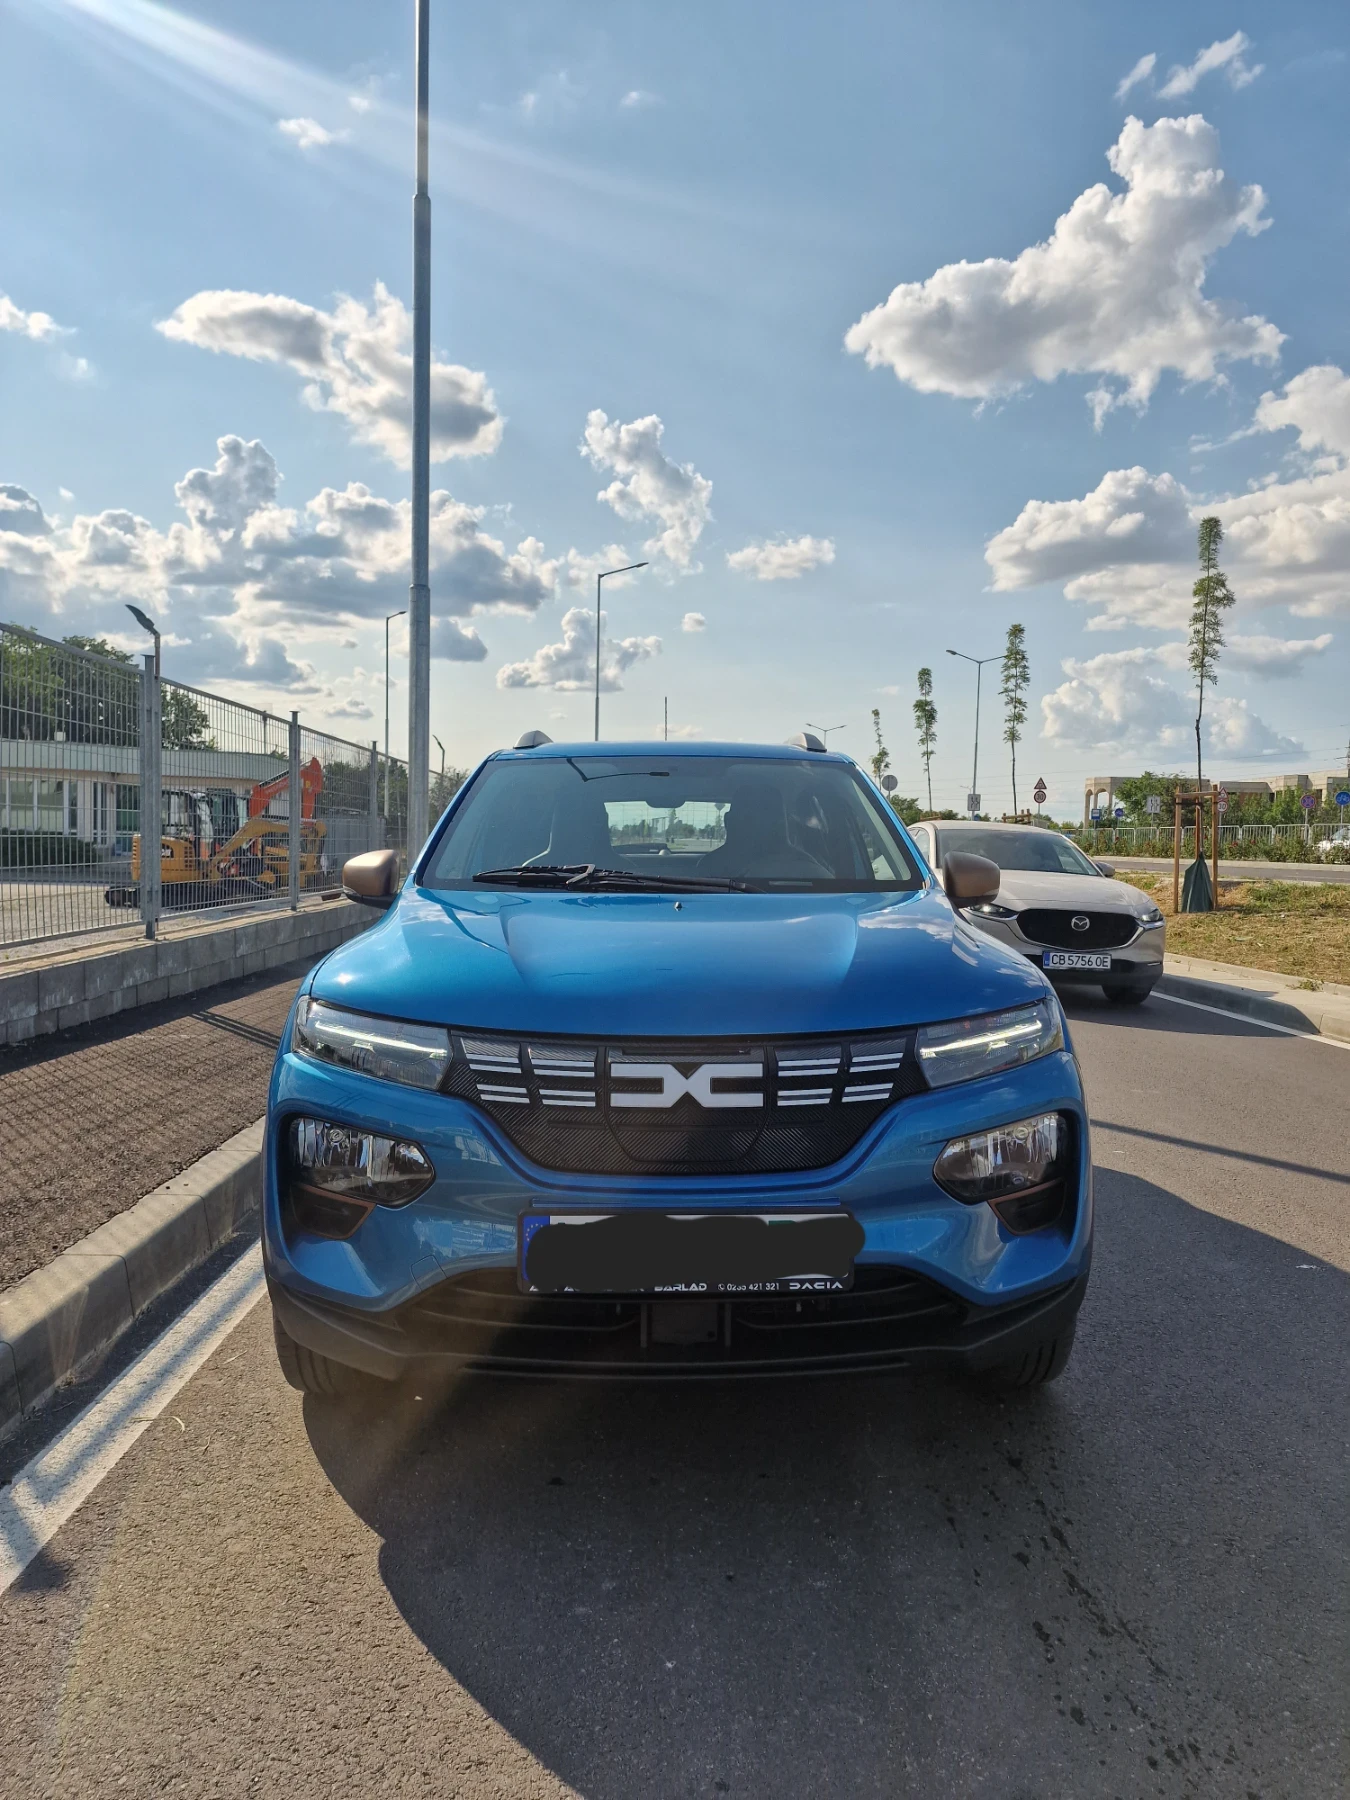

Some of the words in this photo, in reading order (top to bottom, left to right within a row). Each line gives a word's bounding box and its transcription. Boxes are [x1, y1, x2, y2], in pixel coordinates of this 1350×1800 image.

[1052, 954, 1066, 965] CB
[1067, 955, 1094, 966] 5756
[748, 1282, 762, 1290] 421
[766, 1282, 780, 1290] 321
[789, 1282, 844, 1290] DACIA
